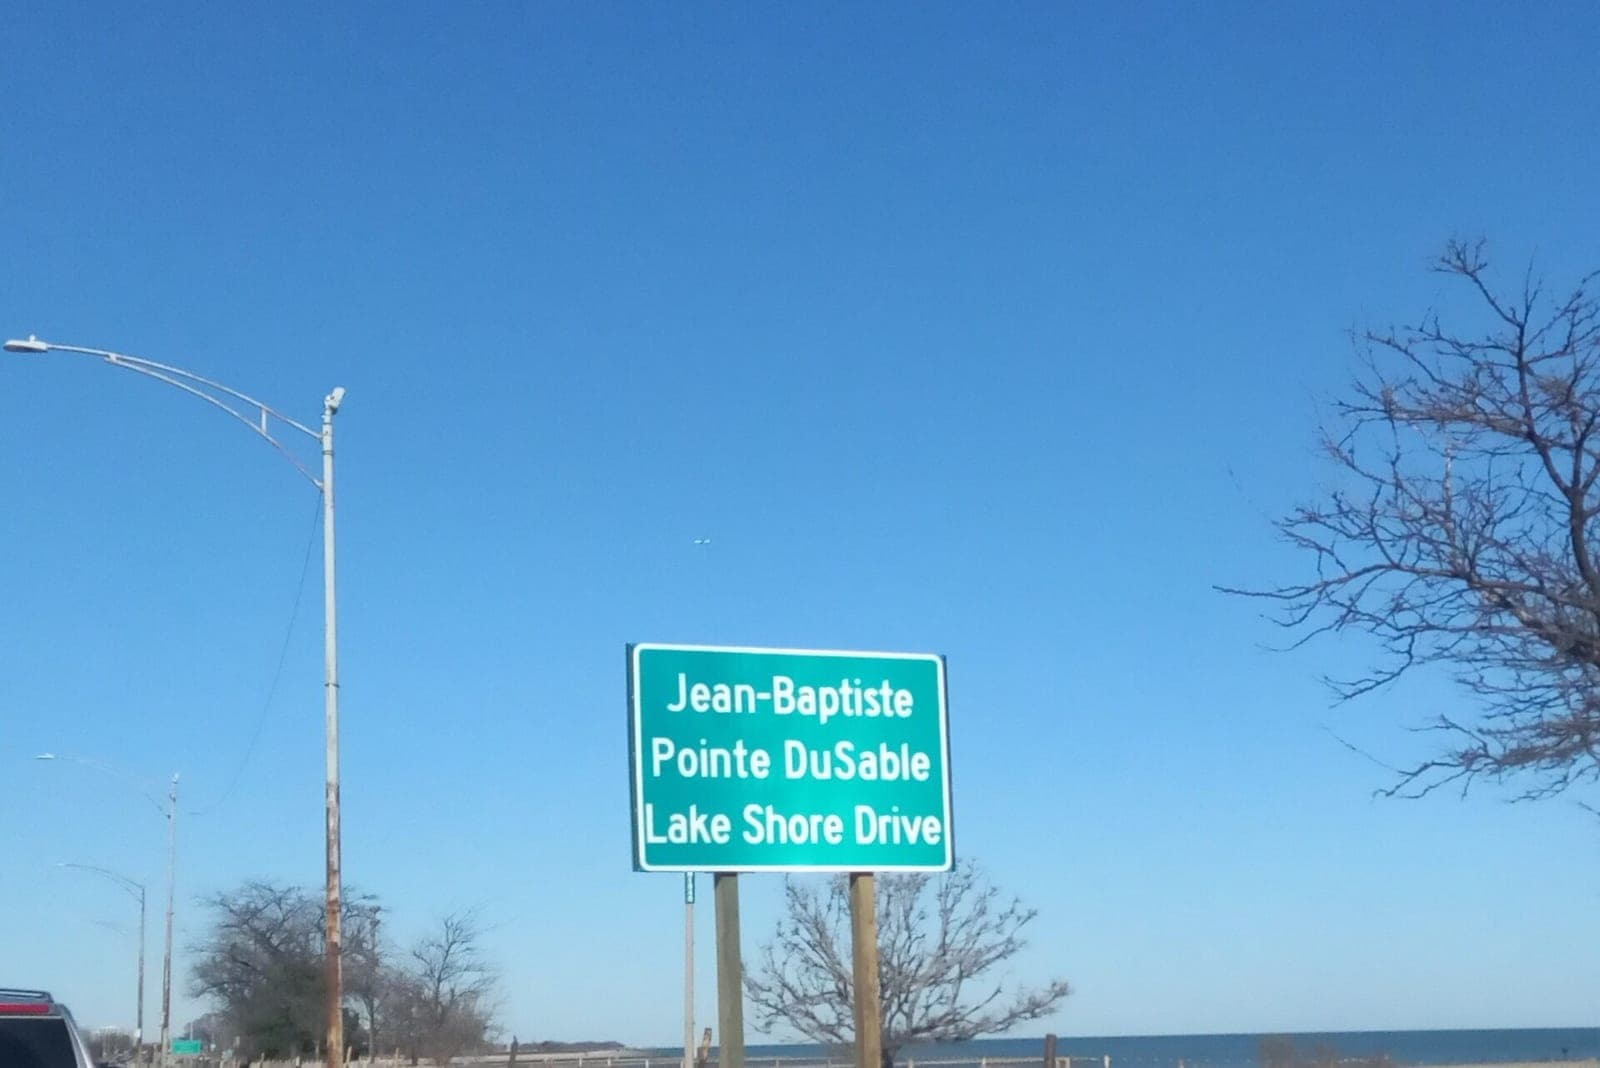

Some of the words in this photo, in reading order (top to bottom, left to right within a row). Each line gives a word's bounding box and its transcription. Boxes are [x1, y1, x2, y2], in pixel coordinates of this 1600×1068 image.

[667, 673, 913, 724] Jean-Baptiste
[652, 737, 771, 779] Pointe
[785, 740, 931, 781] DuSable
[646, 803, 731, 844] Lake
[743, 803, 843, 845] Shore
[855, 805, 941, 845] Drive
